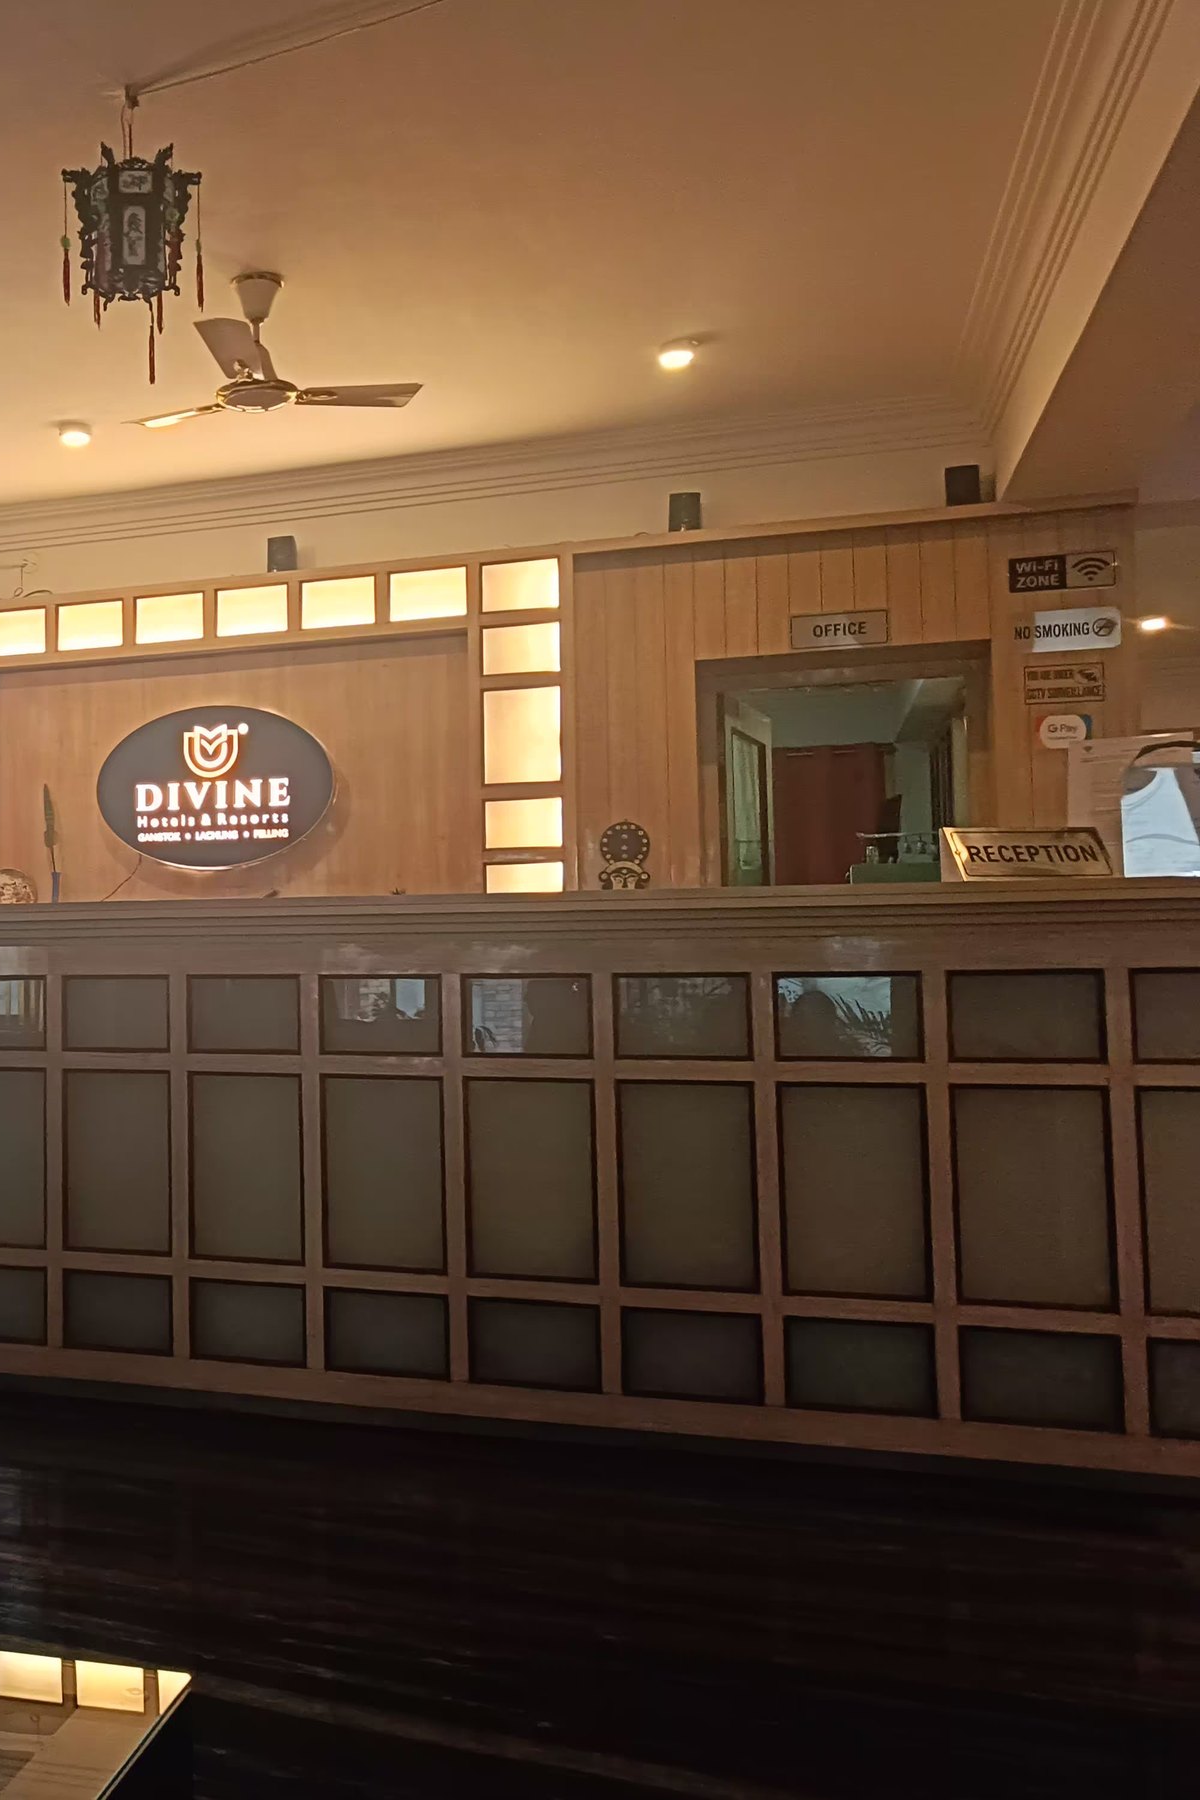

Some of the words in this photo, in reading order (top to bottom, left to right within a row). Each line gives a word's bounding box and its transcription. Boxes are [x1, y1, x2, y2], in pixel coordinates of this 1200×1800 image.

[1016, 574, 1060, 588] ZONE
[812, 621, 867, 638] OFFICE
[1014, 626, 1031, 639] NO
[1035, 622, 1090, 638] SMOKING
[135, 777, 291, 811] DIVINE
[137, 814, 196, 828] Hotels
[217, 812, 289, 826] Resorts
[966, 844, 1099, 863] RECEPTION
